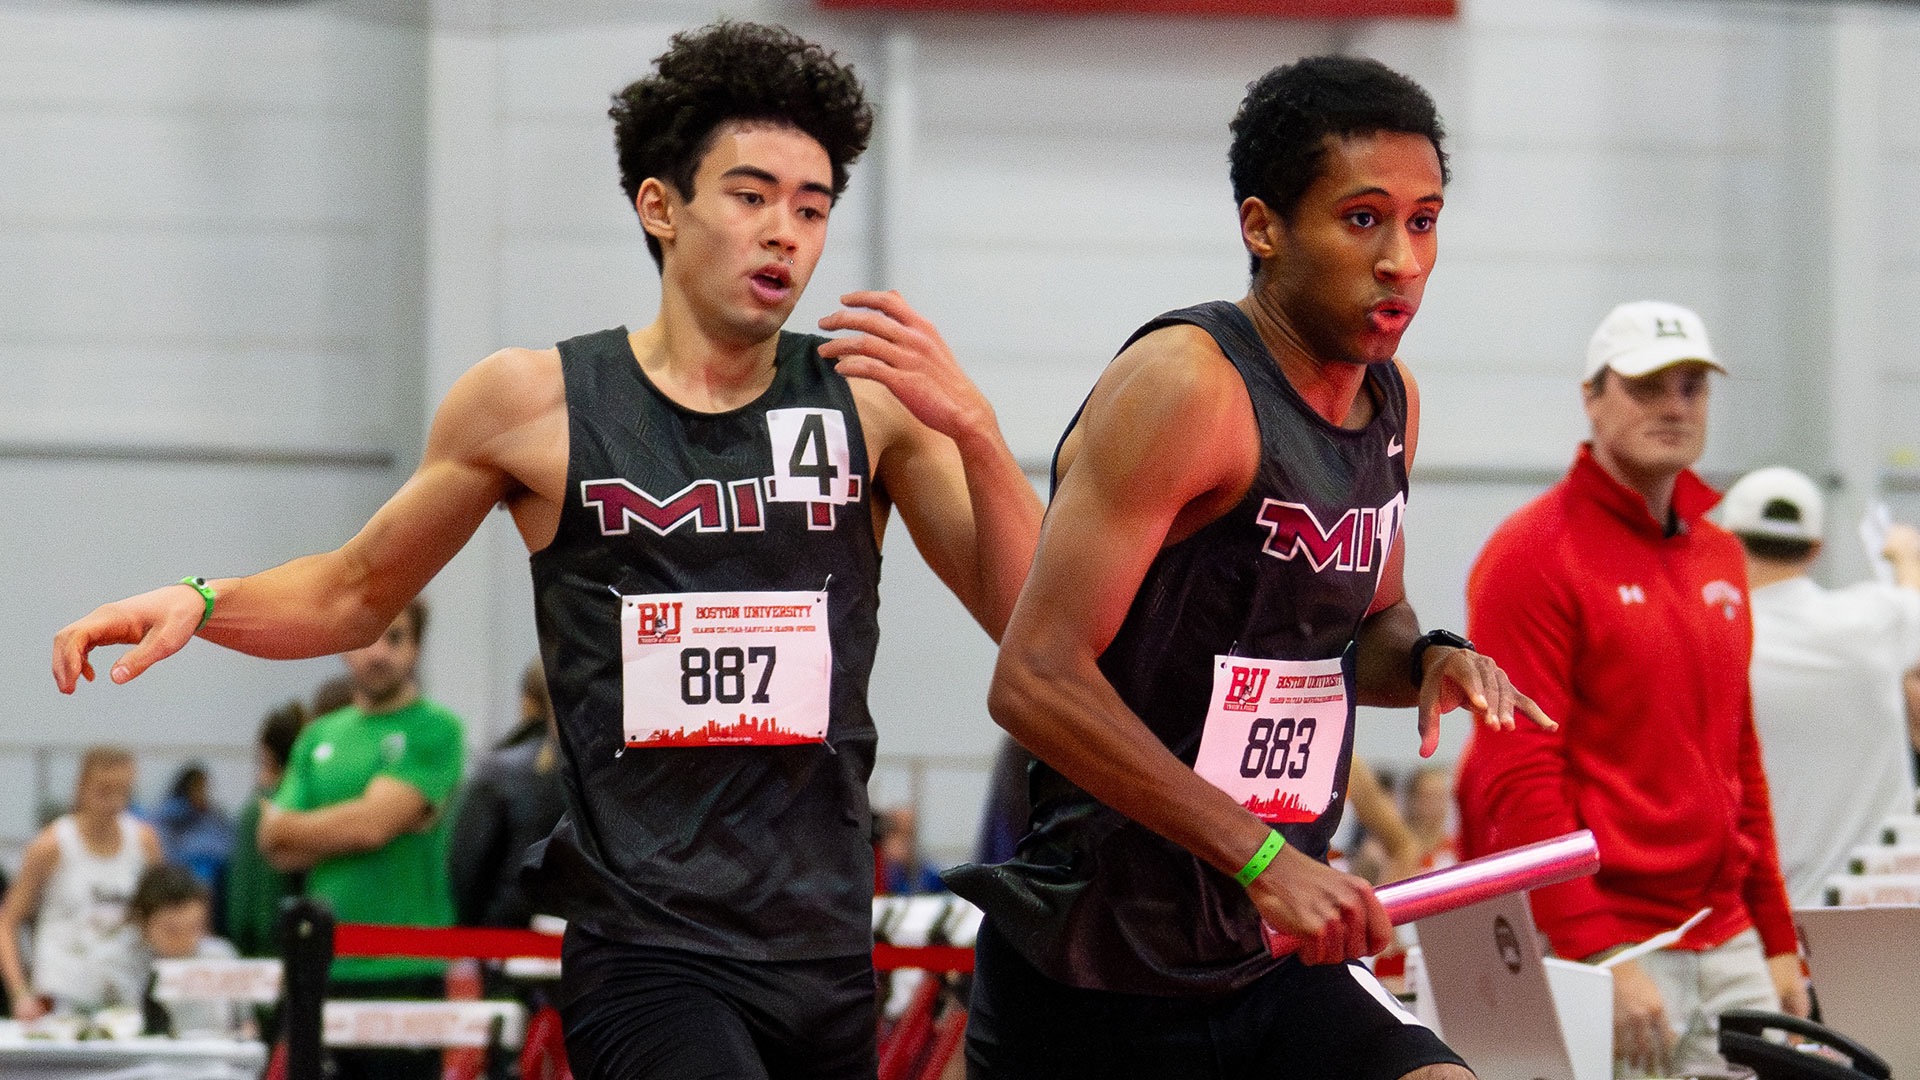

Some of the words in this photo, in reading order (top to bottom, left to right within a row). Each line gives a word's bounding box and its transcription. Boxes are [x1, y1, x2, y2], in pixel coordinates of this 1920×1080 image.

[789, 413, 838, 497] 4
[1255, 497, 1383, 573] MI
[638, 602, 683, 636] BU
[696, 606, 740, 619] BOSTON
[743, 605, 812, 619] UNIVERSITY
[680, 646, 776, 705] 887
[1225, 666, 1270, 703] BU
[1239, 718, 1317, 779] 883
